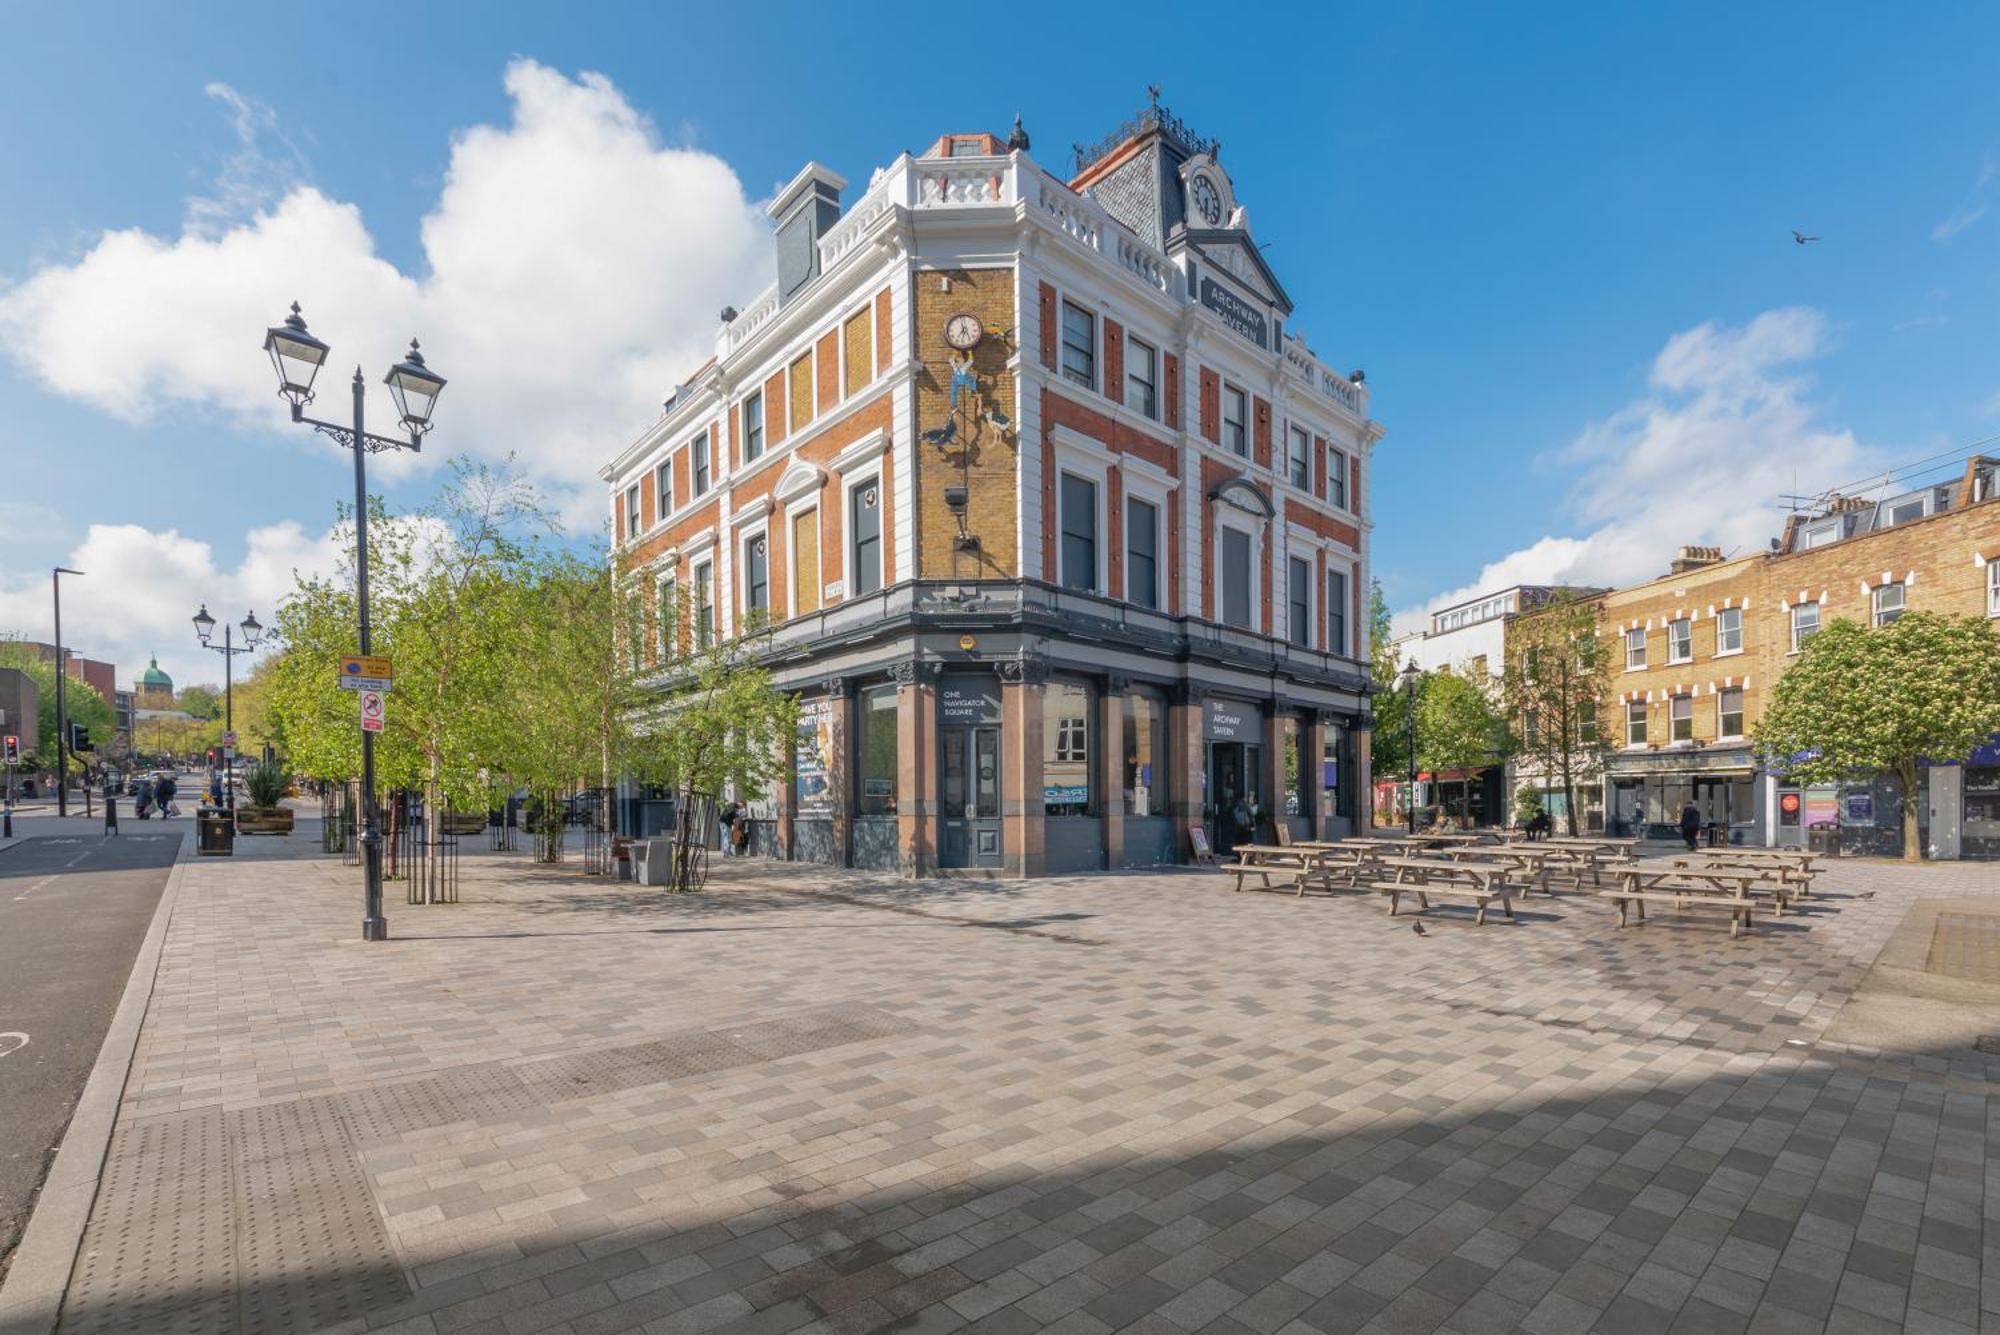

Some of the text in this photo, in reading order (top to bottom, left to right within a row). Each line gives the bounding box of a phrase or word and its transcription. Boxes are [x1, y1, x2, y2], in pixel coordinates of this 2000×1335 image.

[1211, 288, 1260, 327] ARCHWAY
[1214, 306, 1257, 342] TAVERN
[944, 691, 961, 699] ONE
[944, 699, 987, 707] NAVIGATOR
[1212, 702, 1224, 712] THE
[945, 708, 973, 716] SQUARE
[1212, 714, 1240, 725] ARCHWAY
[1213, 726, 1234, 736] TAVERN
